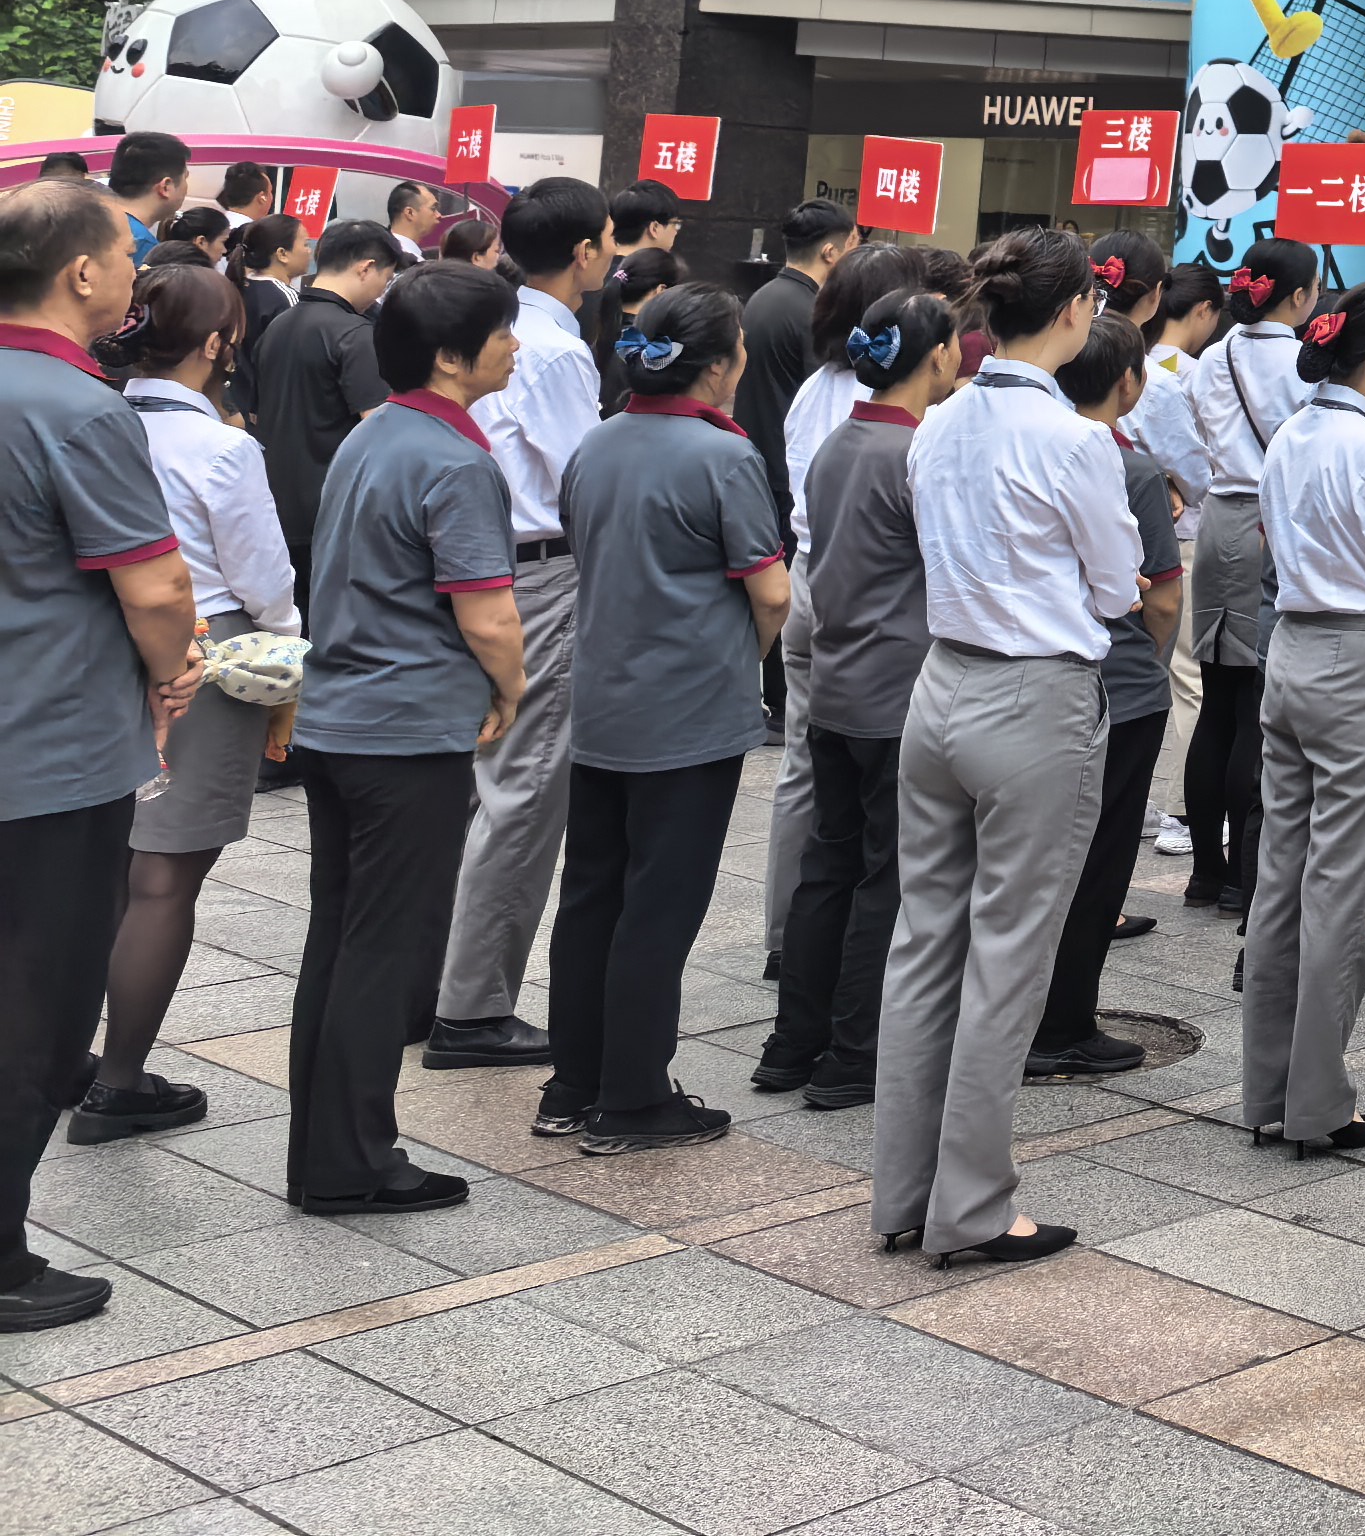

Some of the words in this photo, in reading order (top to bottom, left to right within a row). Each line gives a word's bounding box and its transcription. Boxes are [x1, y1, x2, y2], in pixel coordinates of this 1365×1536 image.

[456, 128, 483, 159] 六楼
[1101, 116, 1153, 152] 三楼
[653, 140, 699, 174] 五楼
[293, 187, 322, 217] 七楼
[876, 167, 921, 204] 四楼
